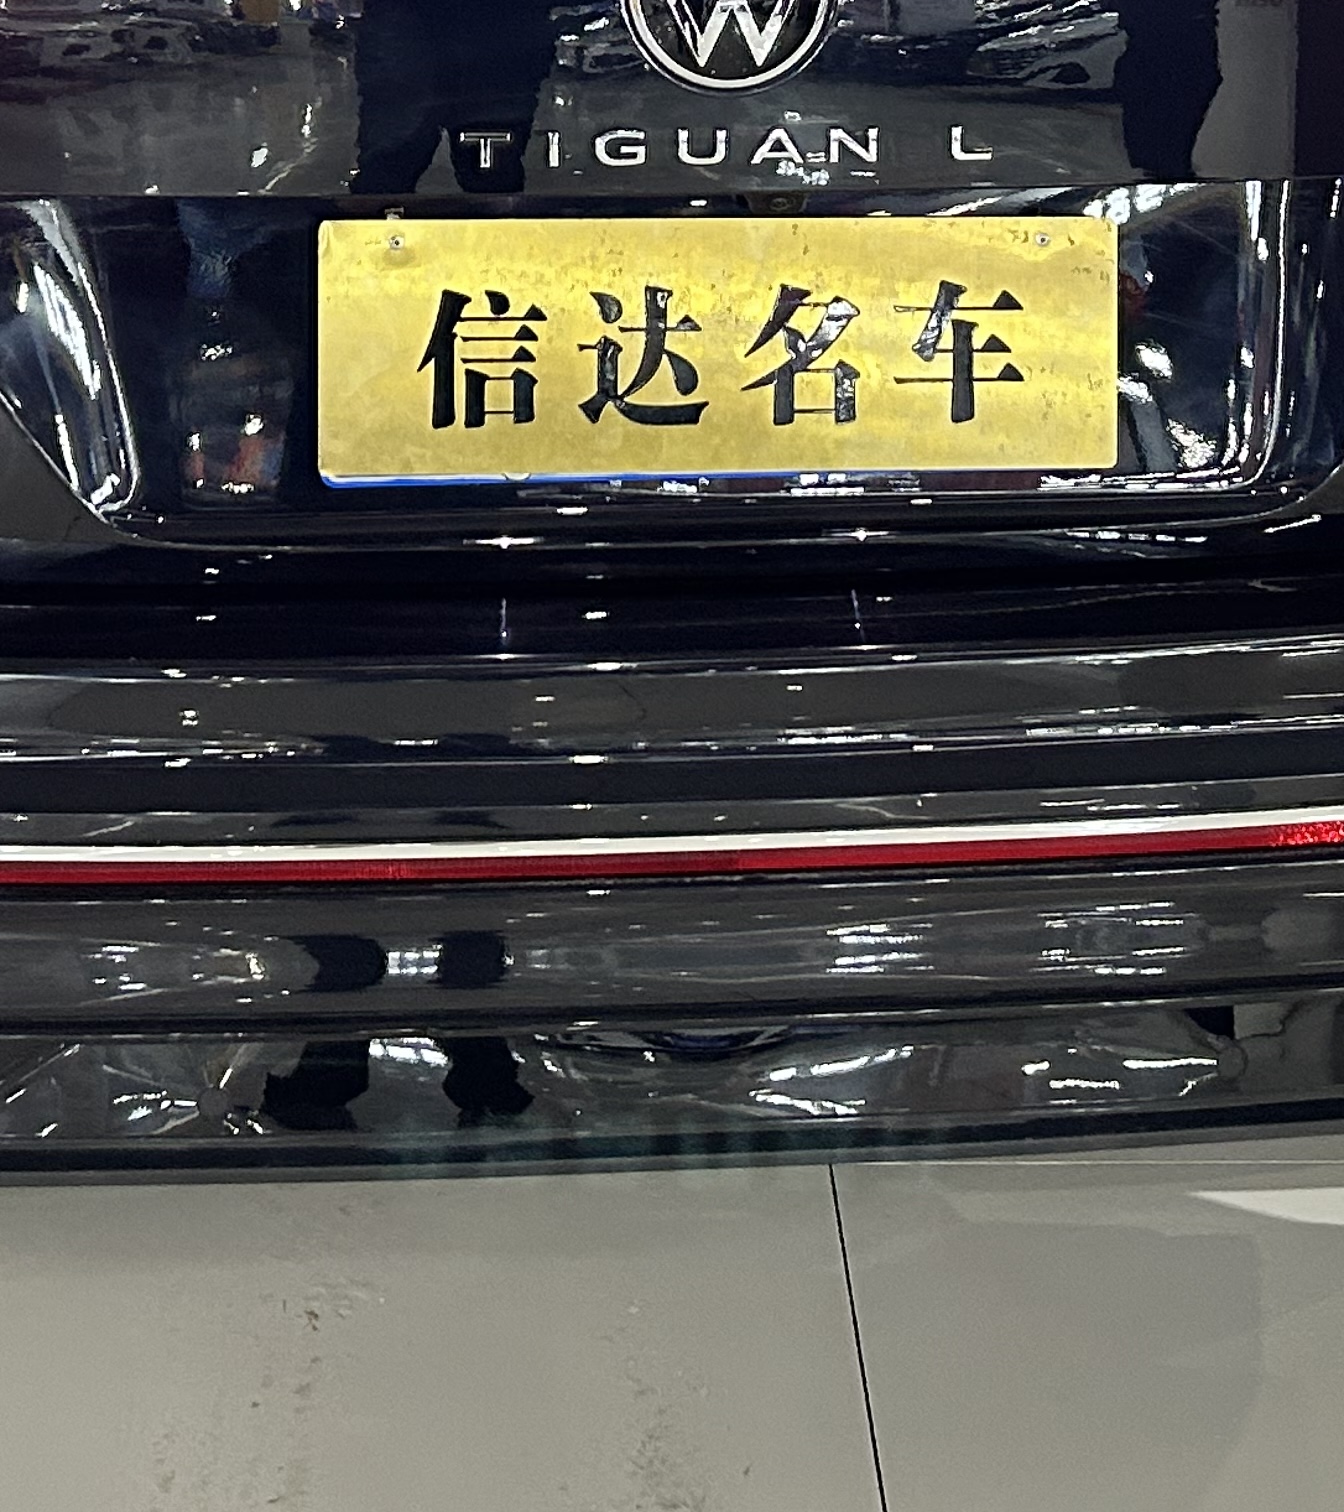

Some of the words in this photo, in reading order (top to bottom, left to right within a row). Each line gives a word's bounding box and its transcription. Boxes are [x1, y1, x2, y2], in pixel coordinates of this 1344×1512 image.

[459, 126, 881, 168] TIGUAN
[949, 126, 994, 162] L
[416, 280, 1026, 430] 信达名车
